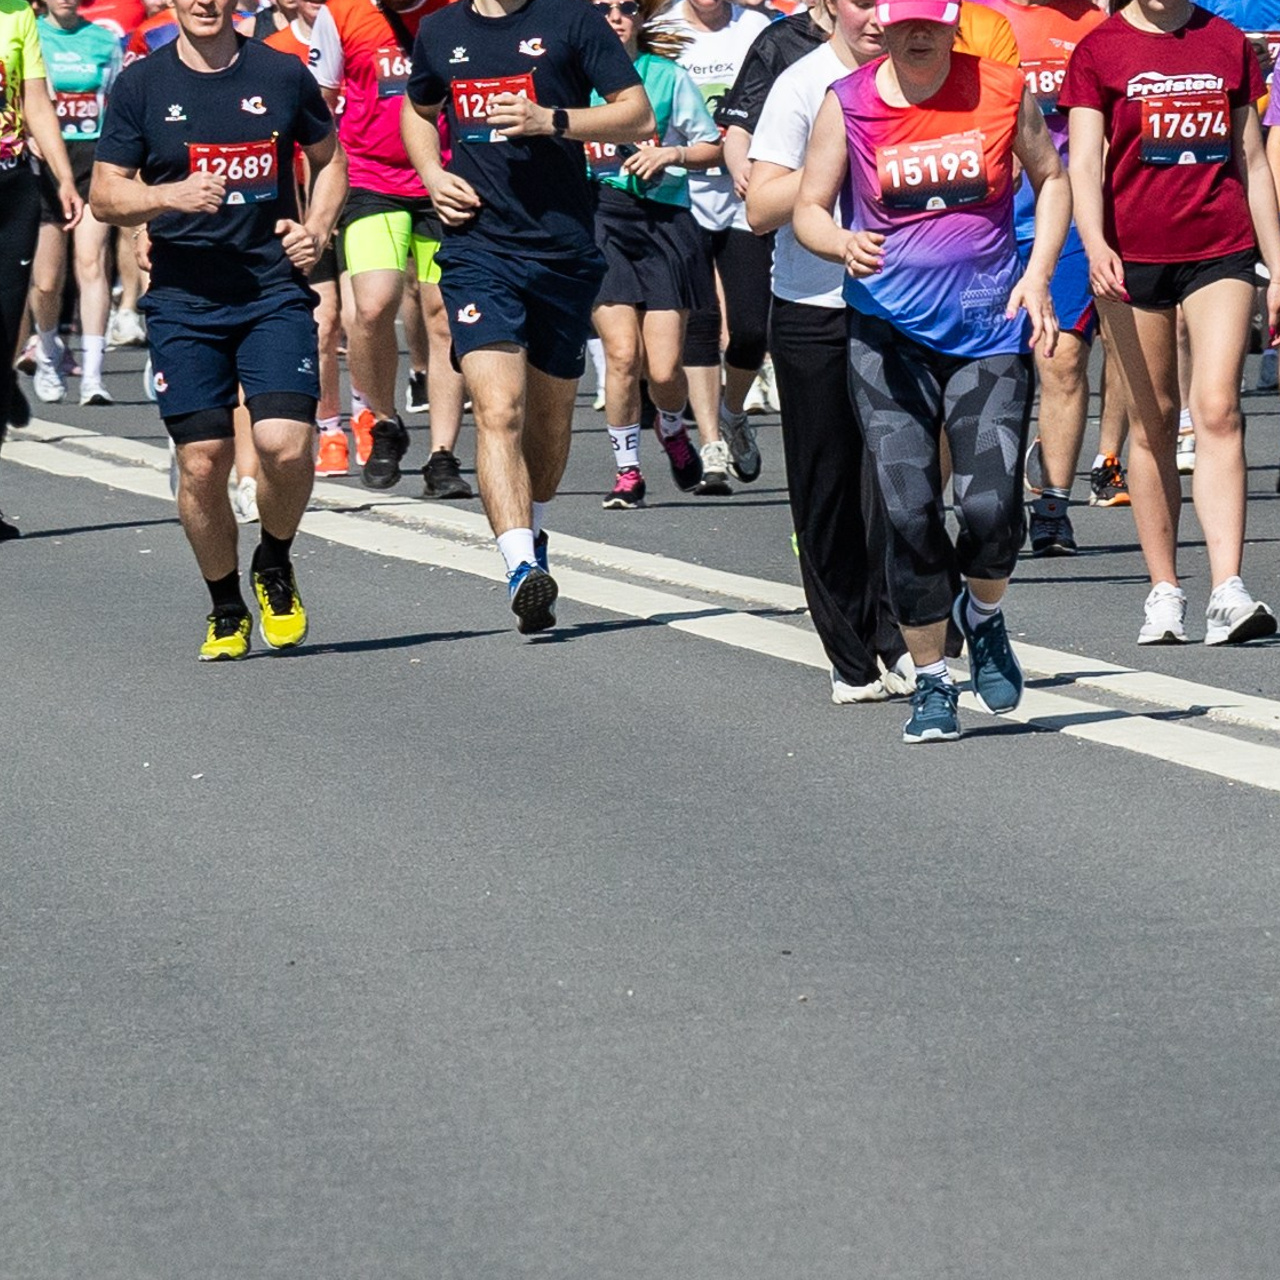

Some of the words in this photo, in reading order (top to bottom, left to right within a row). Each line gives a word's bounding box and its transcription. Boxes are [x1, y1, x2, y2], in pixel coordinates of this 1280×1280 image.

[1127, 78, 1223, 97] Profsteel
[56, 100, 99, 117] 6120
[1148, 111, 1227, 138] 17674
[196, 153, 273, 180] 12689
[885, 150, 980, 188] 15193
